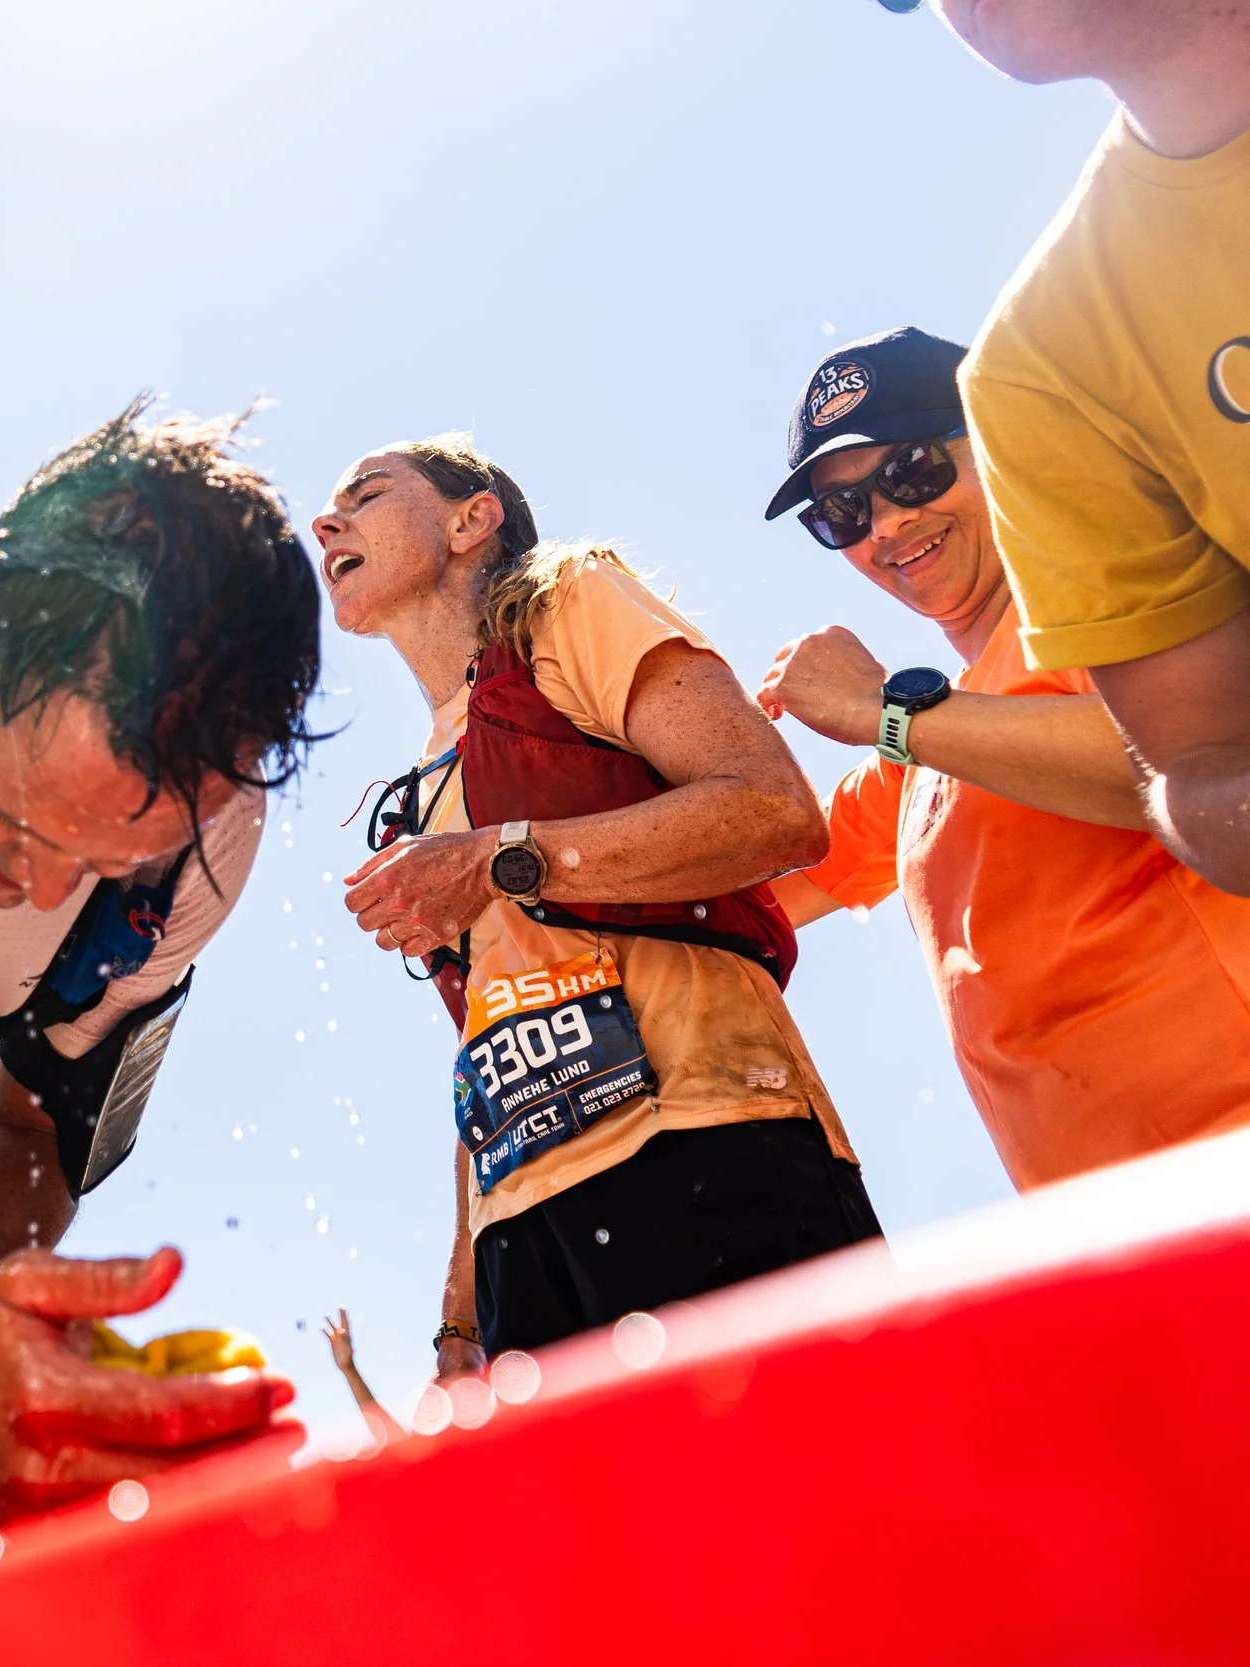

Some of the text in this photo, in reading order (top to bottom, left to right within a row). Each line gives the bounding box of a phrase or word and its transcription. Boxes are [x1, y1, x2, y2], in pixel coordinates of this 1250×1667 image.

[819, 366, 838, 384] 13
[811, 372, 864, 418] PEAKS
[470, 1004, 593, 1099] 3309
[551, 1060, 590, 1087] LUND
[579, 1070, 642, 1103] EMERGENCIES
[583, 1101, 603, 1115] 021
[602, 1093, 623, 1107] 023
[491, 1105, 558, 1166] RMB UTCT
